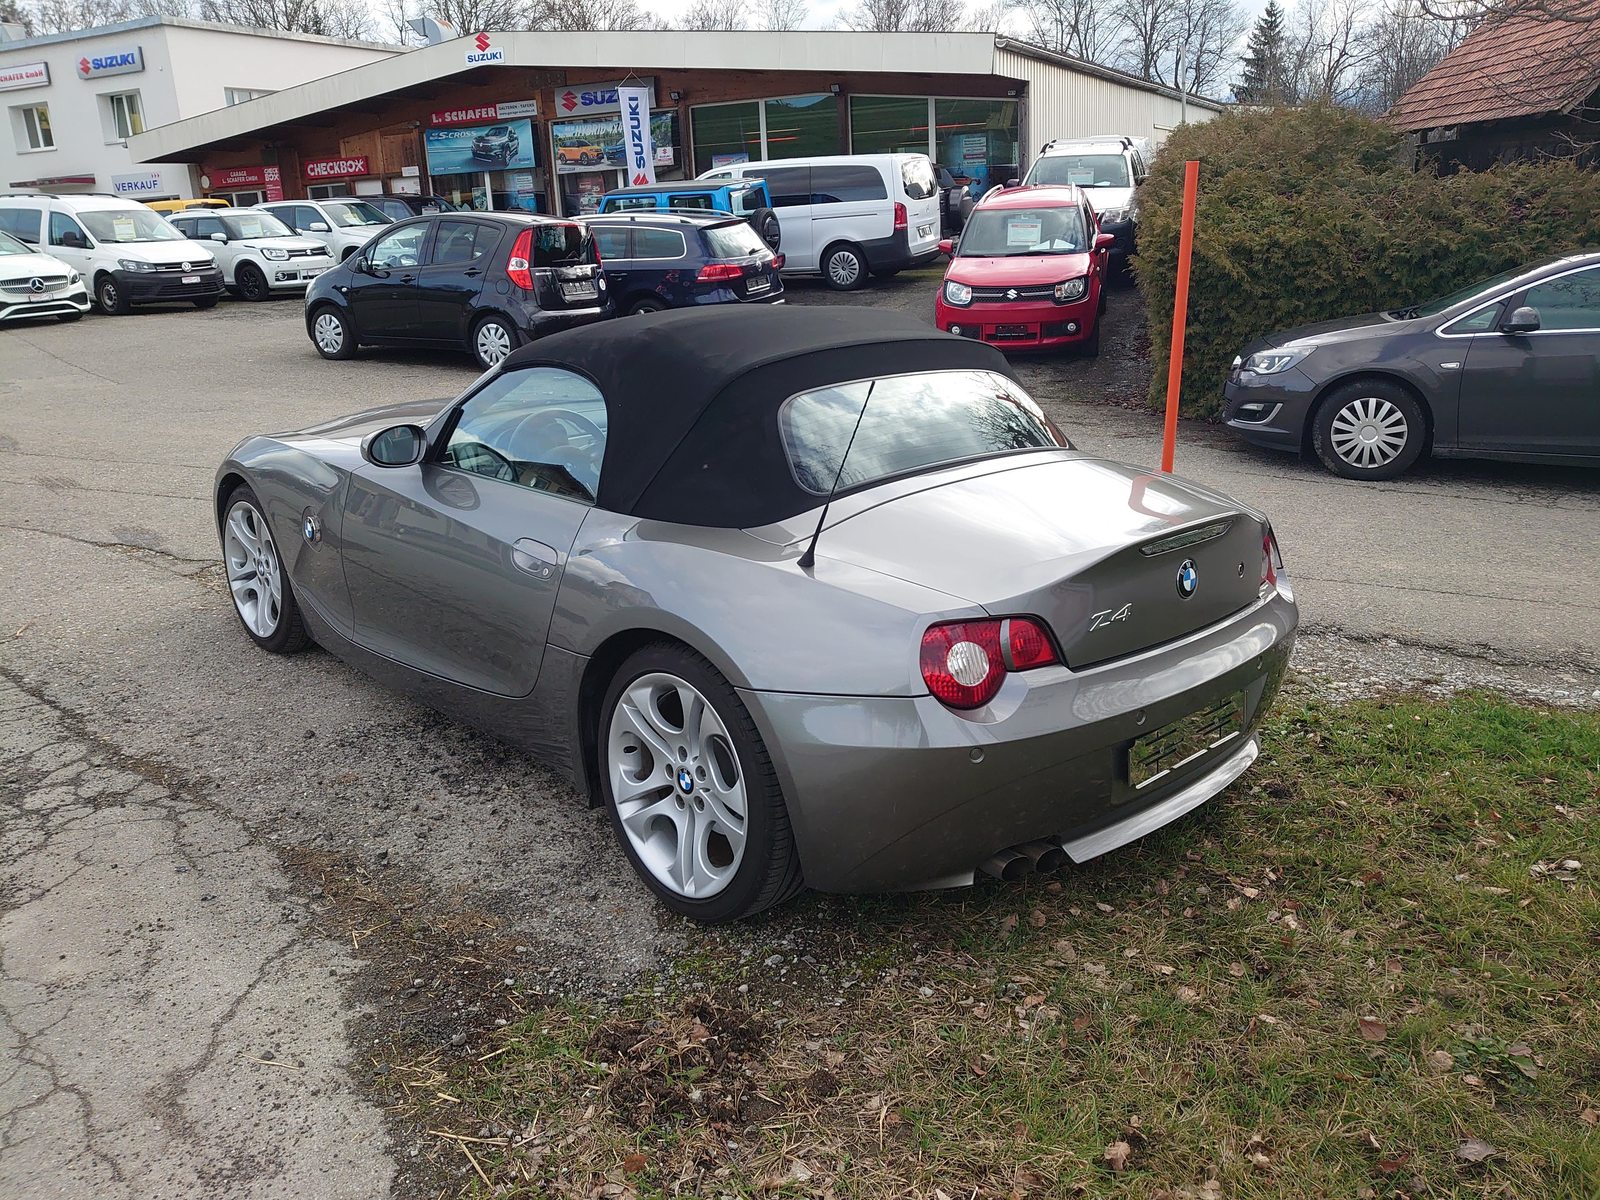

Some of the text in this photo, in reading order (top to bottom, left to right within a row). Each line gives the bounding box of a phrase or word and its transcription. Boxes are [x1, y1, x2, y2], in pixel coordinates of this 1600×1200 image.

[92, 53, 135, 70] SUZUKI
[467, 51, 502, 63] SUZUKI
[581, 90, 619, 107] SUZ
[432, 114, 442, 123] L.
[628, 96, 645, 169] SUZUKI
[307, 159, 365, 176] CHECKBOX
[115, 179, 158, 192] VERKAUF
[265, 173, 280, 181] BOX
[1090, 602, 1132, 632] Z4
